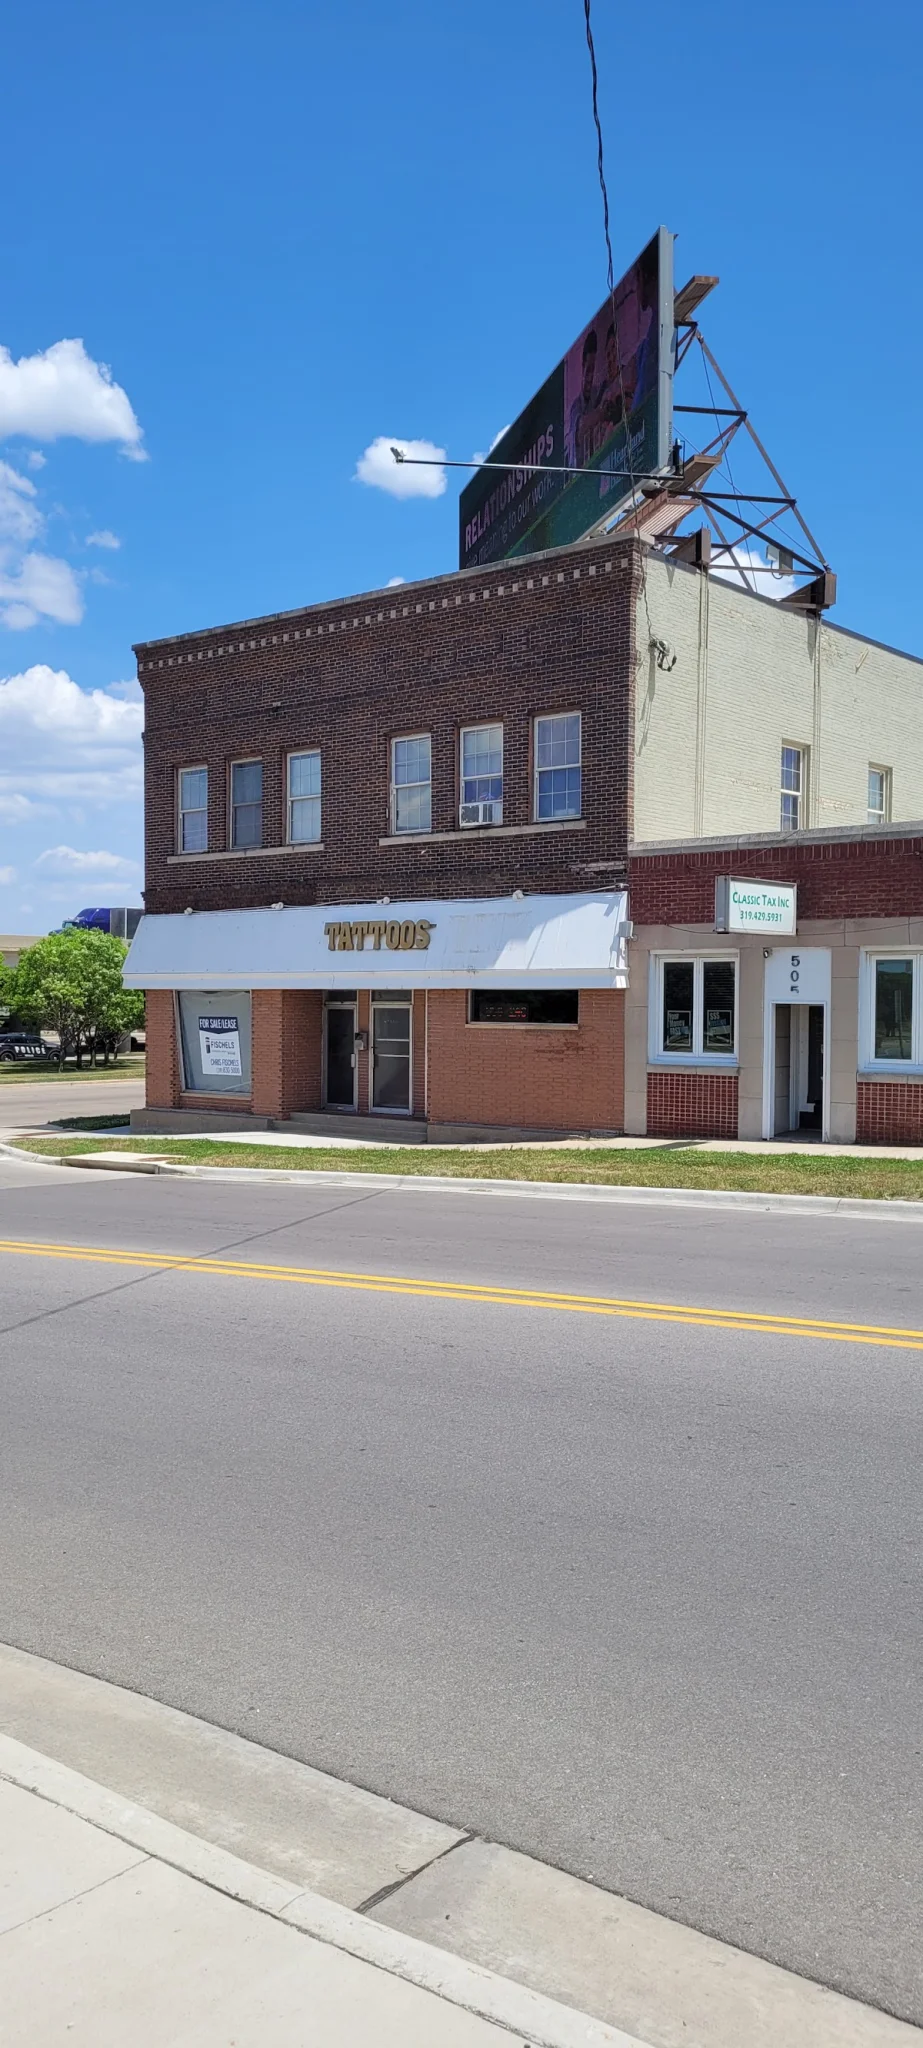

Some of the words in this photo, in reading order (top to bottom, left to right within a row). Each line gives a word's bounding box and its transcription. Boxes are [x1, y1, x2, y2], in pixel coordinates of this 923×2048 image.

[465, 424, 554, 552] RELATIONSHIPS
[517, 494, 531, 523] our
[740, 910, 782, 922] 319.429.5931
[324, 919, 433, 951] TATTOOS
[199, 1018, 209, 1028] FOR
[209, 1018, 237, 1029] SALE/LEASE
[14, 1046, 46, 1055] POLICE
[211, 1041, 235, 1049] FISCHELS
